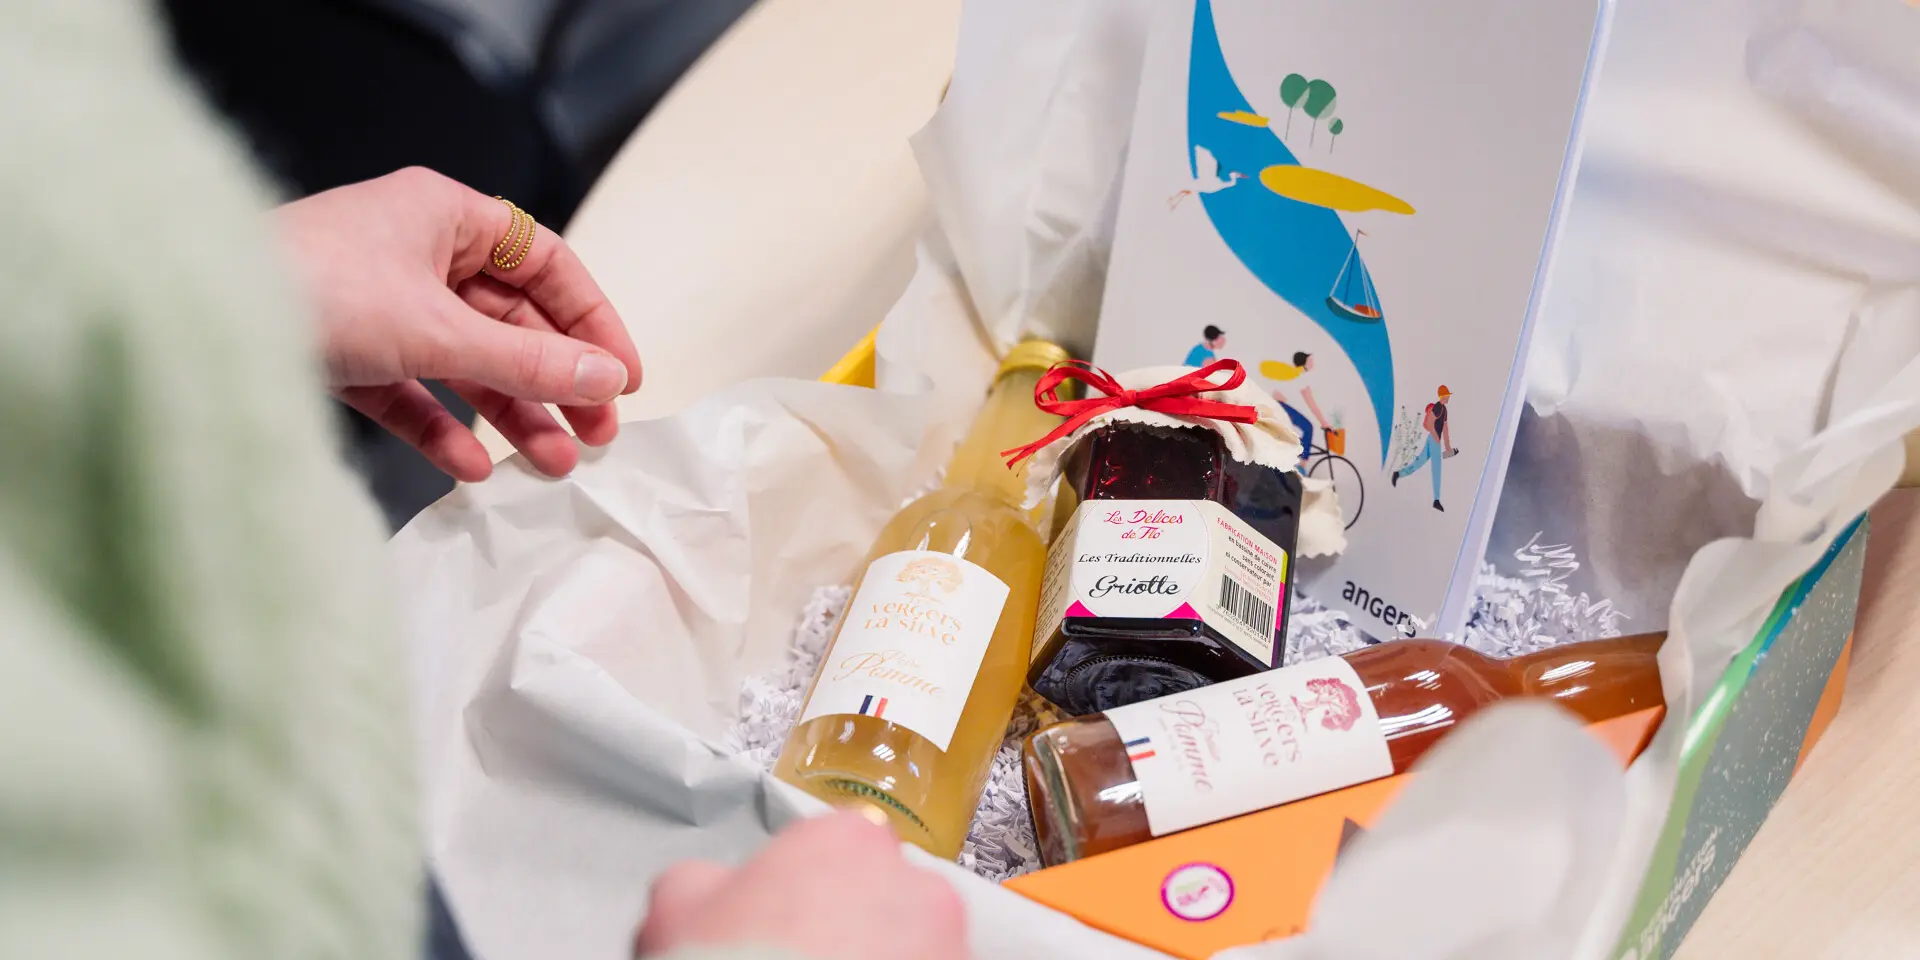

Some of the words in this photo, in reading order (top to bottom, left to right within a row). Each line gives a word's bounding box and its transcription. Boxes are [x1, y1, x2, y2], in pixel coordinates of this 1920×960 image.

[1103, 510, 1124, 524] Les
[1127, 509, 1183, 524] Délices
[1121, 529, 1136, 539] de
[1217, 517, 1254, 548] FABRICATION
[1078, 553, 1101, 563] Les
[1105, 553, 1202, 564] Traditionnelles
[1242, 555, 1254, 566] sans
[1230, 556, 1262, 580] conservateur
[1261, 560, 1277, 573] cuivre
[1089, 575, 1181, 598] Griotte
